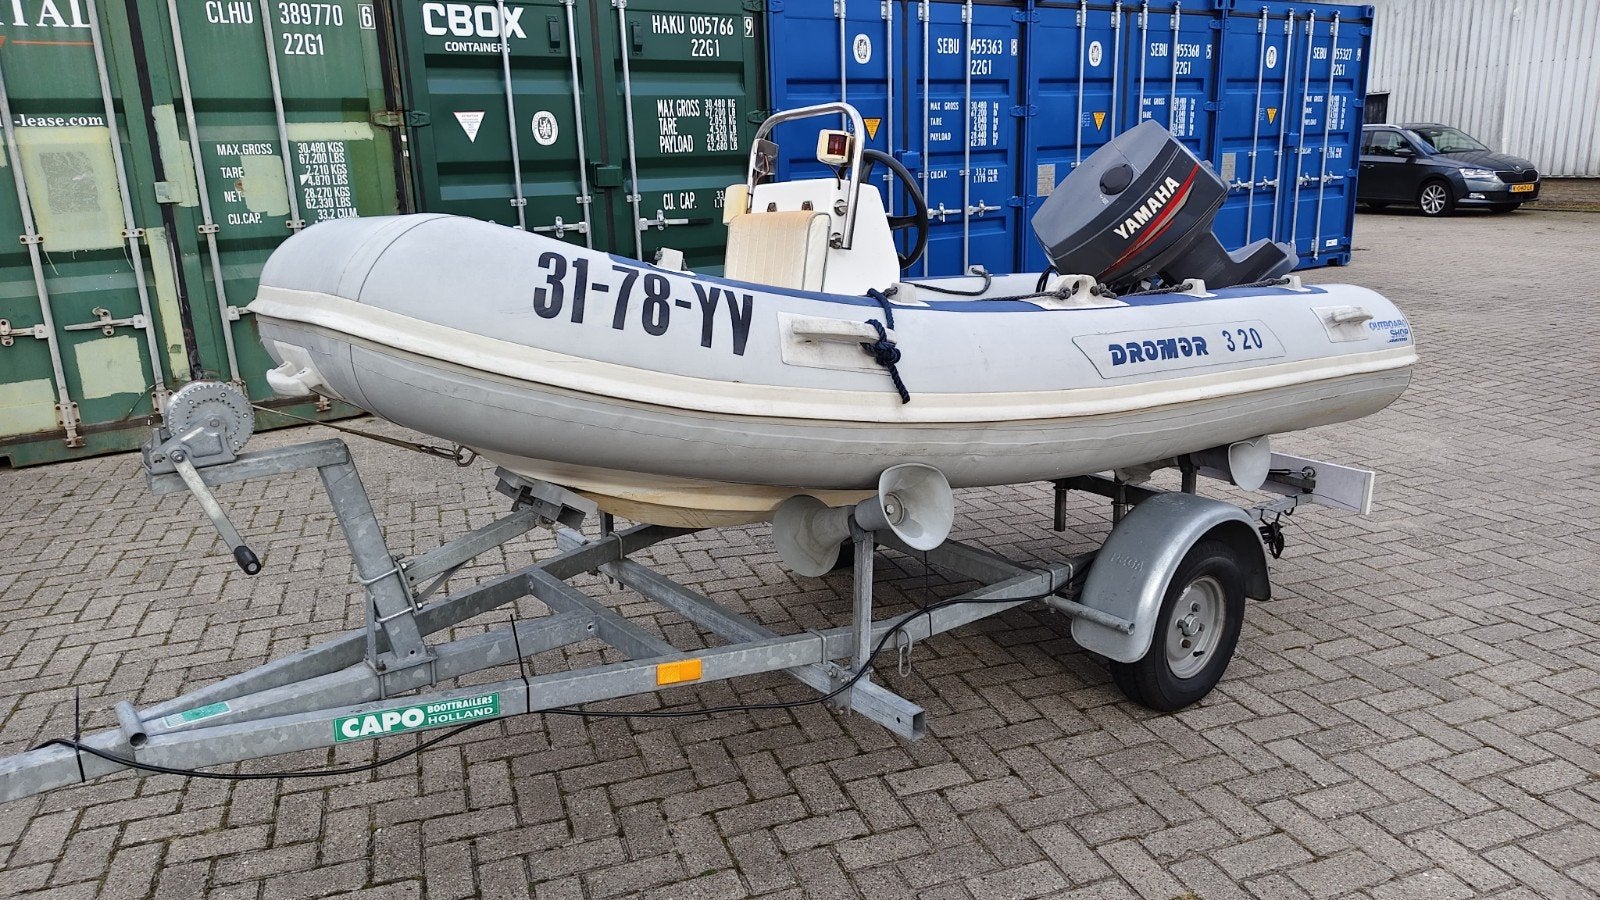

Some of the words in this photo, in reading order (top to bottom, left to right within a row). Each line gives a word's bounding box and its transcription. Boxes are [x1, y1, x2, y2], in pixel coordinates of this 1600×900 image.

[205, 0, 254, 24] CLHU
[278, 2, 344, 27] 389770
[360, 5, 374, 28] 6
[422, 2, 528, 39] CBOX
[652, 14, 685, 34] HAKU
[689, 16, 734, 36] 005766
[744, 18, 753, 37] 9
[282, 33, 325, 56] 22G1
[691, 38, 720, 57] 22G1
[937, 37, 960, 54] SEBU
[970, 38, 1003, 55] 455363
[1150, 42, 1169, 57] SEBU
[1312, 47, 1327, 60] SEBU
[1335, 48, 1353, 60] 55327
[971, 59, 992, 75] 22G1
[1176, 61, 1191, 75] 22G1
[656, 99, 675, 118] MAX
[676, 99, 701, 117] GROSS
[704, 98, 726, 108] 30.480
[727, 98, 736, 108] KG
[728, 107, 736, 117] LB
[930, 101, 941, 111] MAX
[944, 101, 959, 111] GROSS
[0, 113, 104, 127] -lease.com
[659, 117, 678, 136] TARE
[729, 116, 737, 126] KG
[930, 117, 943, 126] TARE
[729, 125, 737, 134] LB
[929, 132, 952, 141] PAYLOAD
[216, 143, 273, 156] MAX.GROSS
[297, 142, 326, 154] 30.480
[327, 142, 345, 153] KGS
[659, 134, 694, 153] PAYLOAD
[730, 133, 738, 143] KG
[730, 142, 738, 151] LB
[298, 153, 327, 165] 67.200
[330, 153, 345, 164] LBS
[220, 166, 245, 179] TARE
[305, 164, 330, 176] 2.210
[331, 164, 348, 175] KGS
[307, 175, 331, 186] 4.870
[333, 174, 348, 185] LBS
[223, 191, 242, 203] NET
[304, 187, 334, 199] 28.270
[334, 187, 351, 198] KGS
[663, 192, 676, 210] CU.
[680, 191, 697, 209] CAP.
[716, 190, 725, 200] 33
[305, 198, 334, 210] 62.330
[336, 197, 351, 208] LBS
[1112, 176, 1181, 240] YAMAHA
[227, 213, 263, 225] CU.CAP.
[317, 209, 336, 220] 33.2
[533, 251, 754, 357] 31-78-YV
[1108, 335, 1210, 367] DROMOR
[341, 707, 425, 738] CAPO
[427, 695, 493, 714] BOOTTRAILERS
[428, 706, 494, 726] HOLLAND
